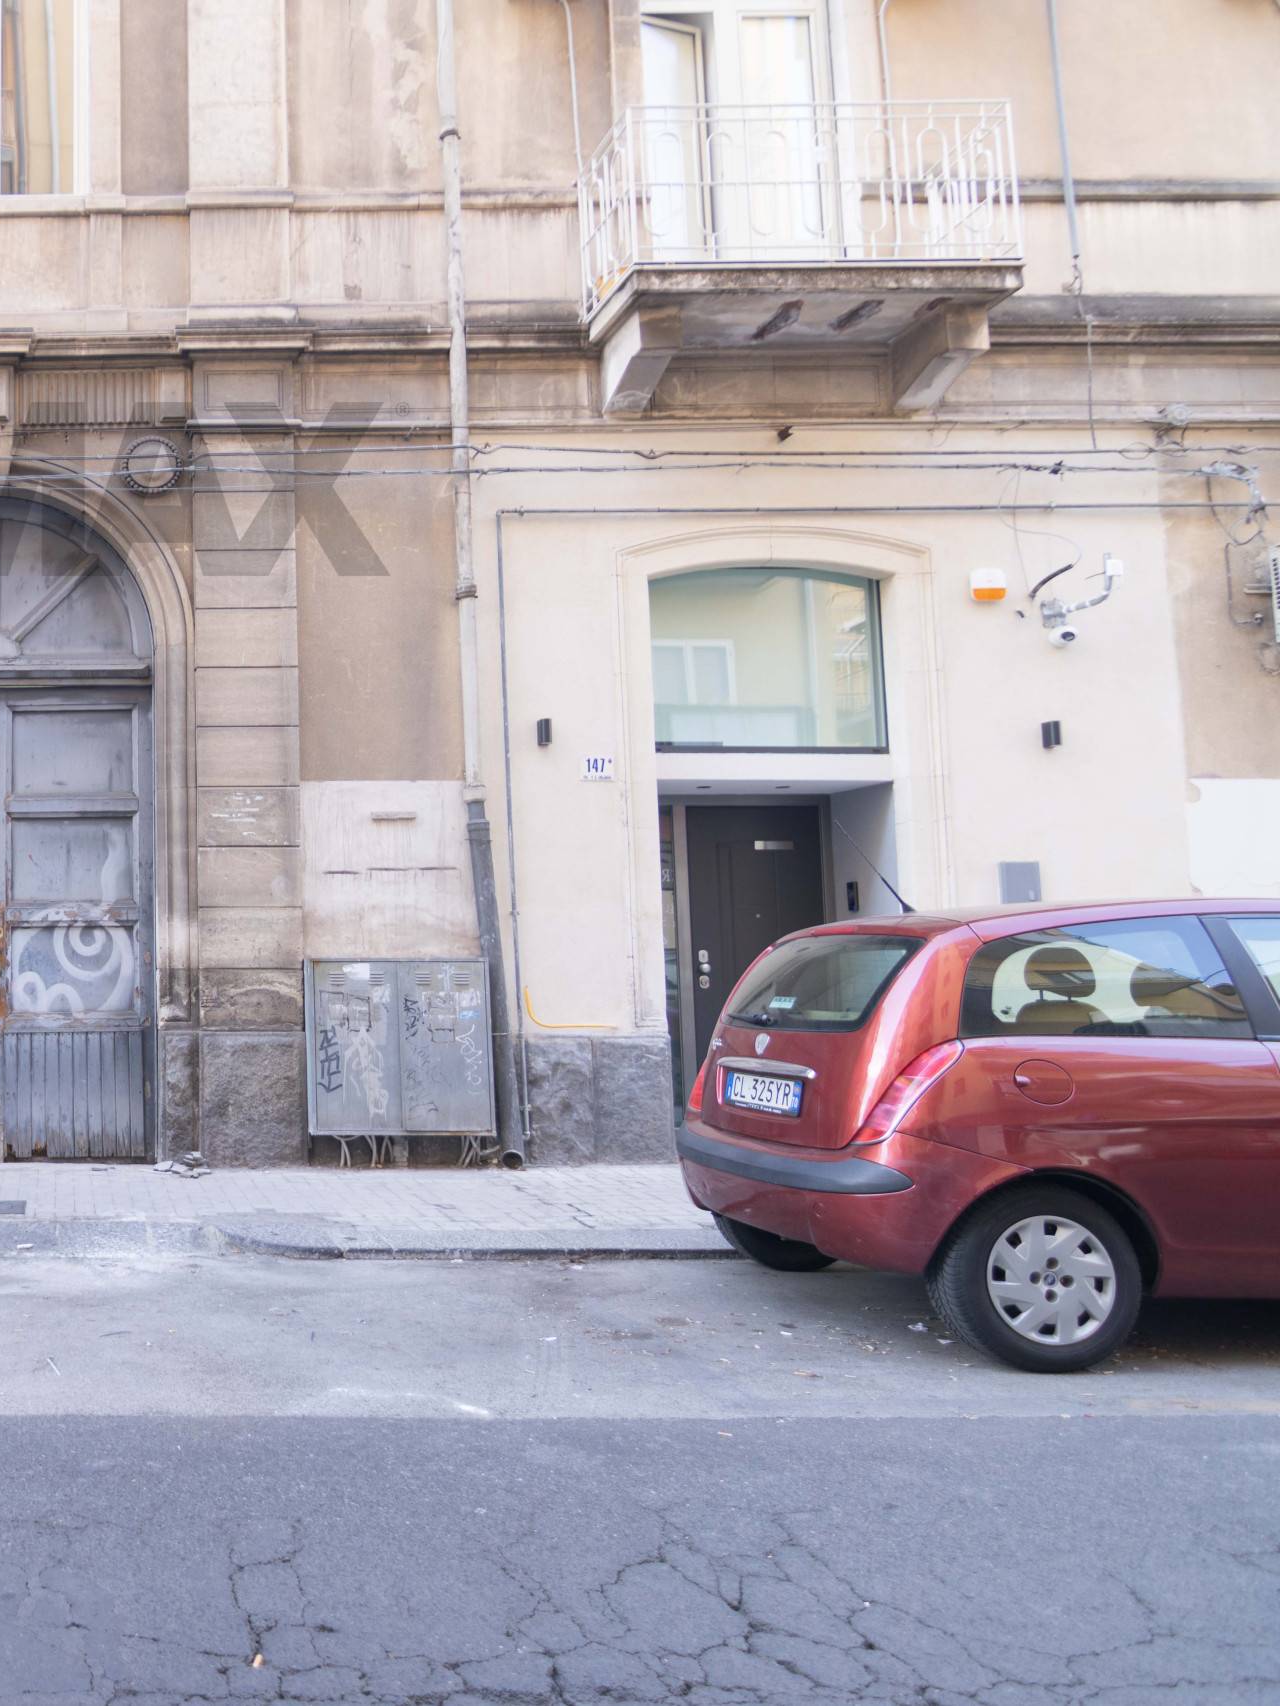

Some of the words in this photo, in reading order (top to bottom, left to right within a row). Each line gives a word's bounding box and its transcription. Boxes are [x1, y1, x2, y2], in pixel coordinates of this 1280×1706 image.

[585, 757, 606, 773] 147
[733, 1075, 746, 1099] CL
[750, 1078, 791, 1107] 325YR
